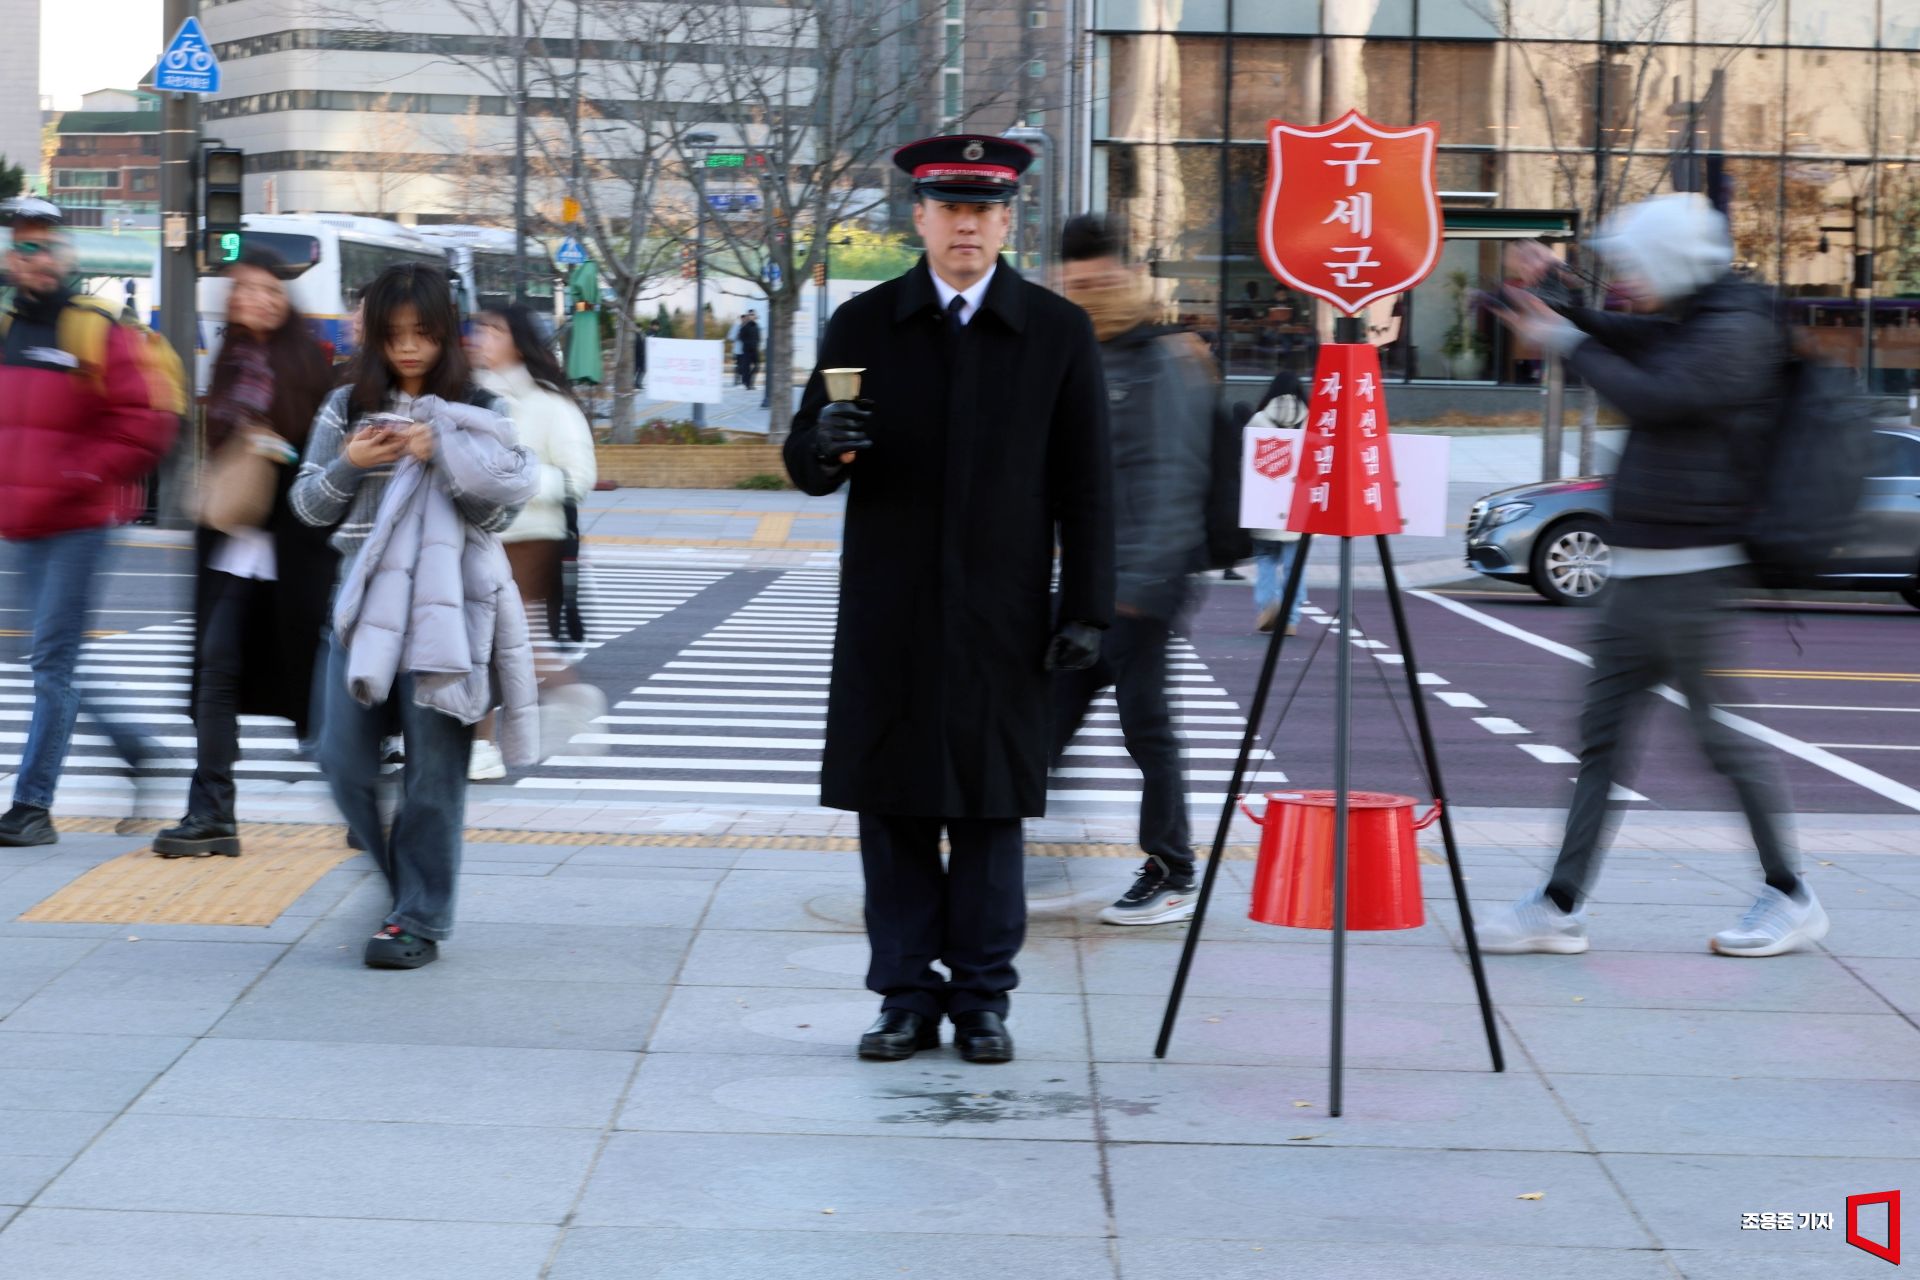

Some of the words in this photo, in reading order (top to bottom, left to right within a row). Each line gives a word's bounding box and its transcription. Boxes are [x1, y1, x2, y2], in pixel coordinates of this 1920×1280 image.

[221, 233, 240, 261] 9
[1321, 141, 1382, 288] 구세군
[1308, 371, 1342, 512] 자선냄비
[1355, 372, 1383, 513] 자선냄비
